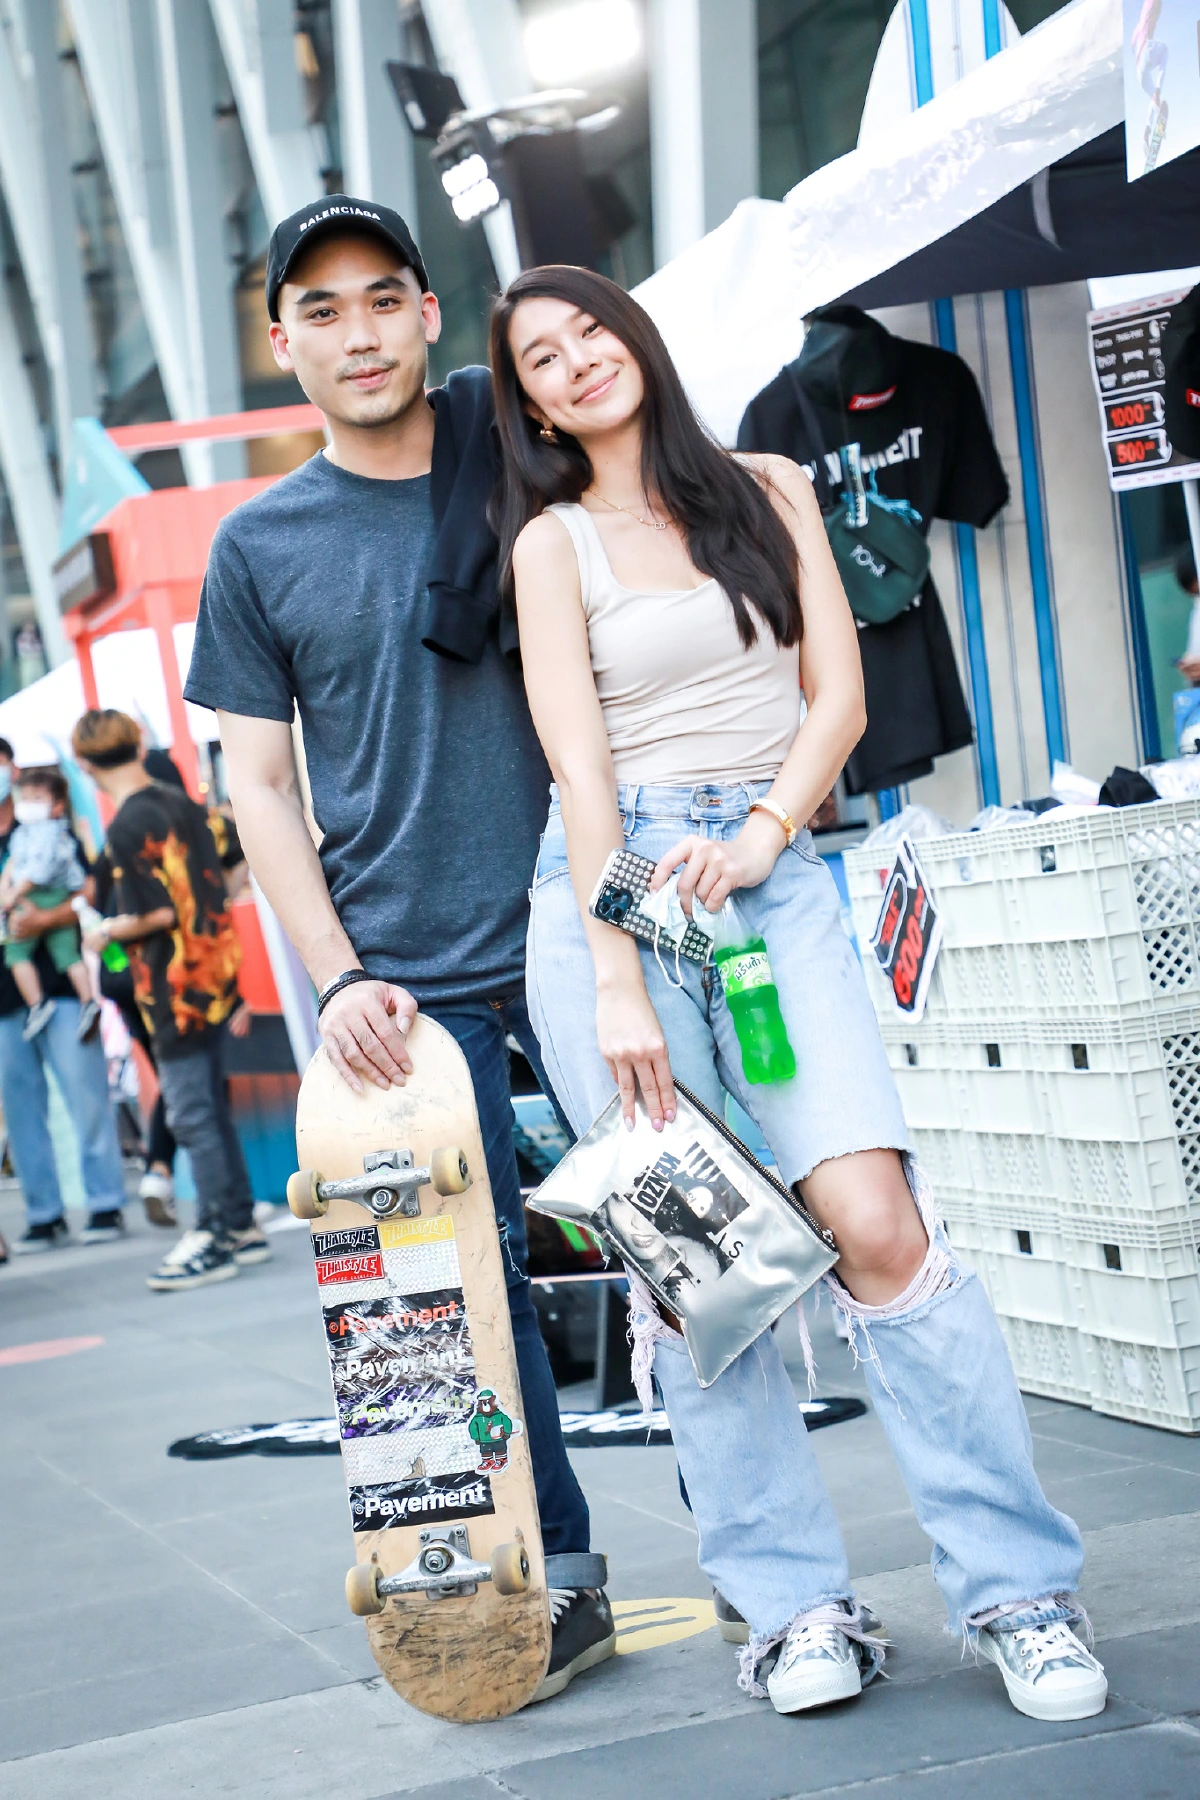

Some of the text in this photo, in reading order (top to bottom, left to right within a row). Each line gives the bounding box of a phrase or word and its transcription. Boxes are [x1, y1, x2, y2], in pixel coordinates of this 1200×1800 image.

[300, 206, 381, 232] BALENCIAGA
[637, 1151, 682, 1209] KENZO
[315, 1228, 375, 1254] THAISTYLE
[383, 1217, 449, 1245] THAISTYLE
[318, 1254, 378, 1281] THAISTYLE
